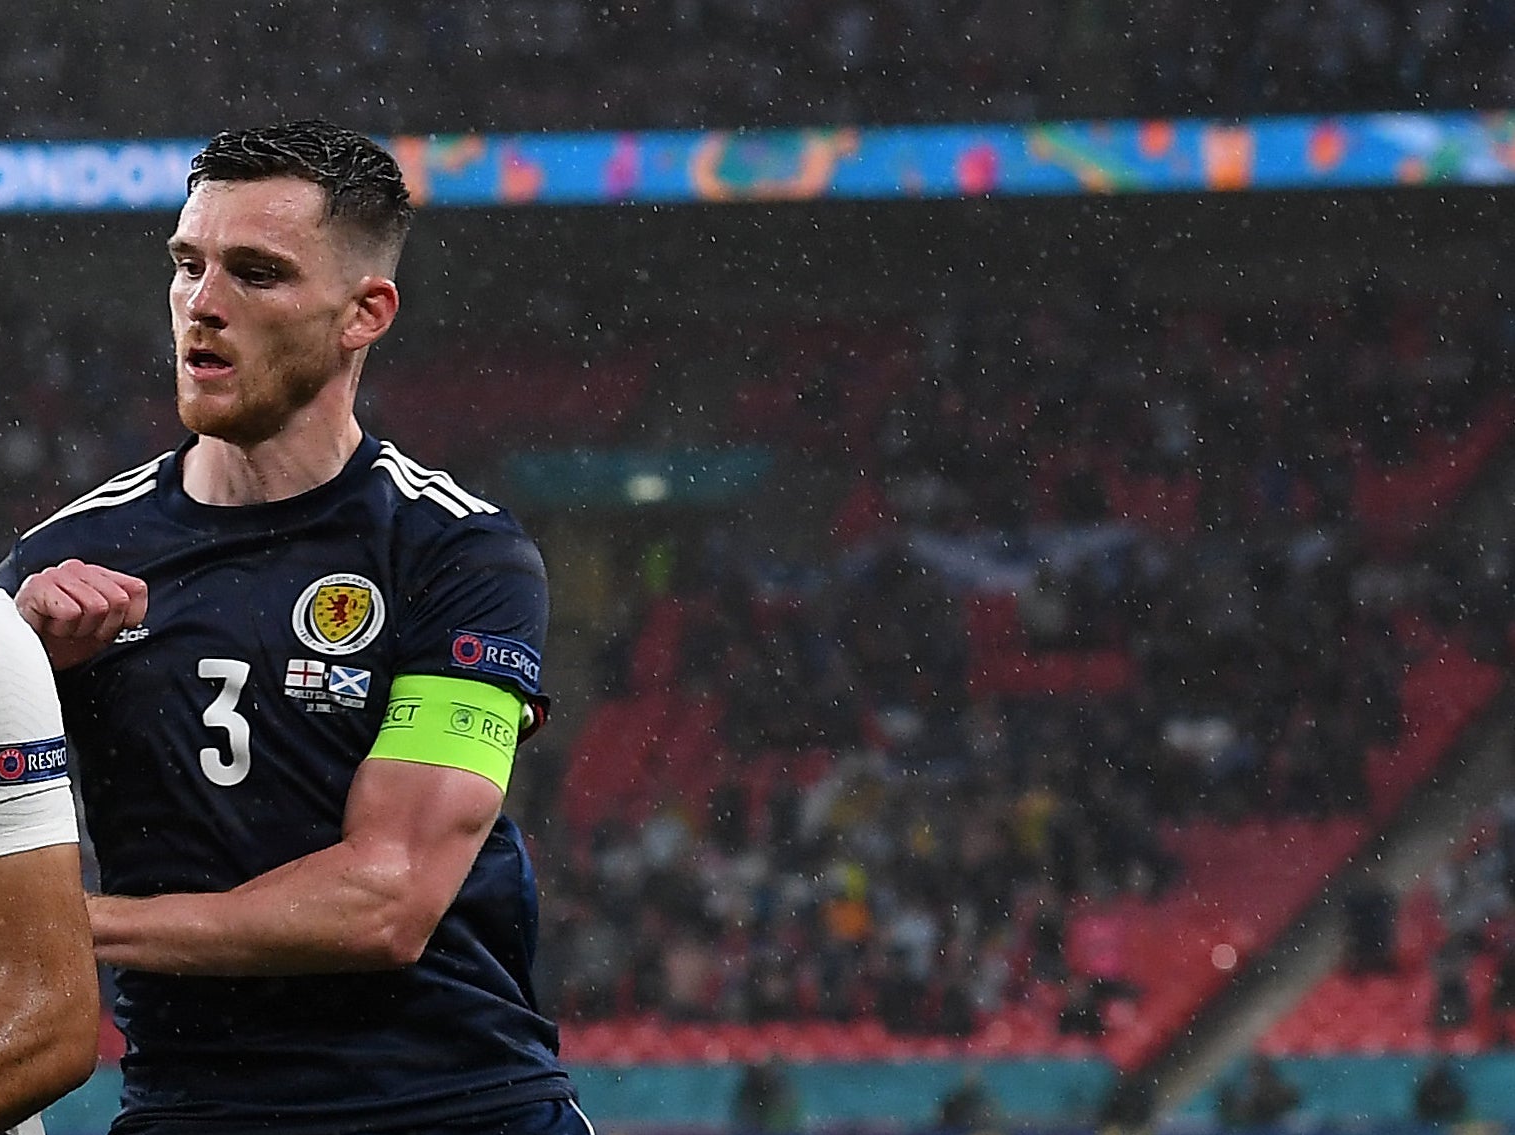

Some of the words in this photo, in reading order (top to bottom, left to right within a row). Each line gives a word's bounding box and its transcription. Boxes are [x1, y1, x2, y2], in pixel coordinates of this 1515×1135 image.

[485, 646, 541, 682] RESPECT
[198, 658, 251, 787] 3
[27, 746, 67, 771] RESPEC
